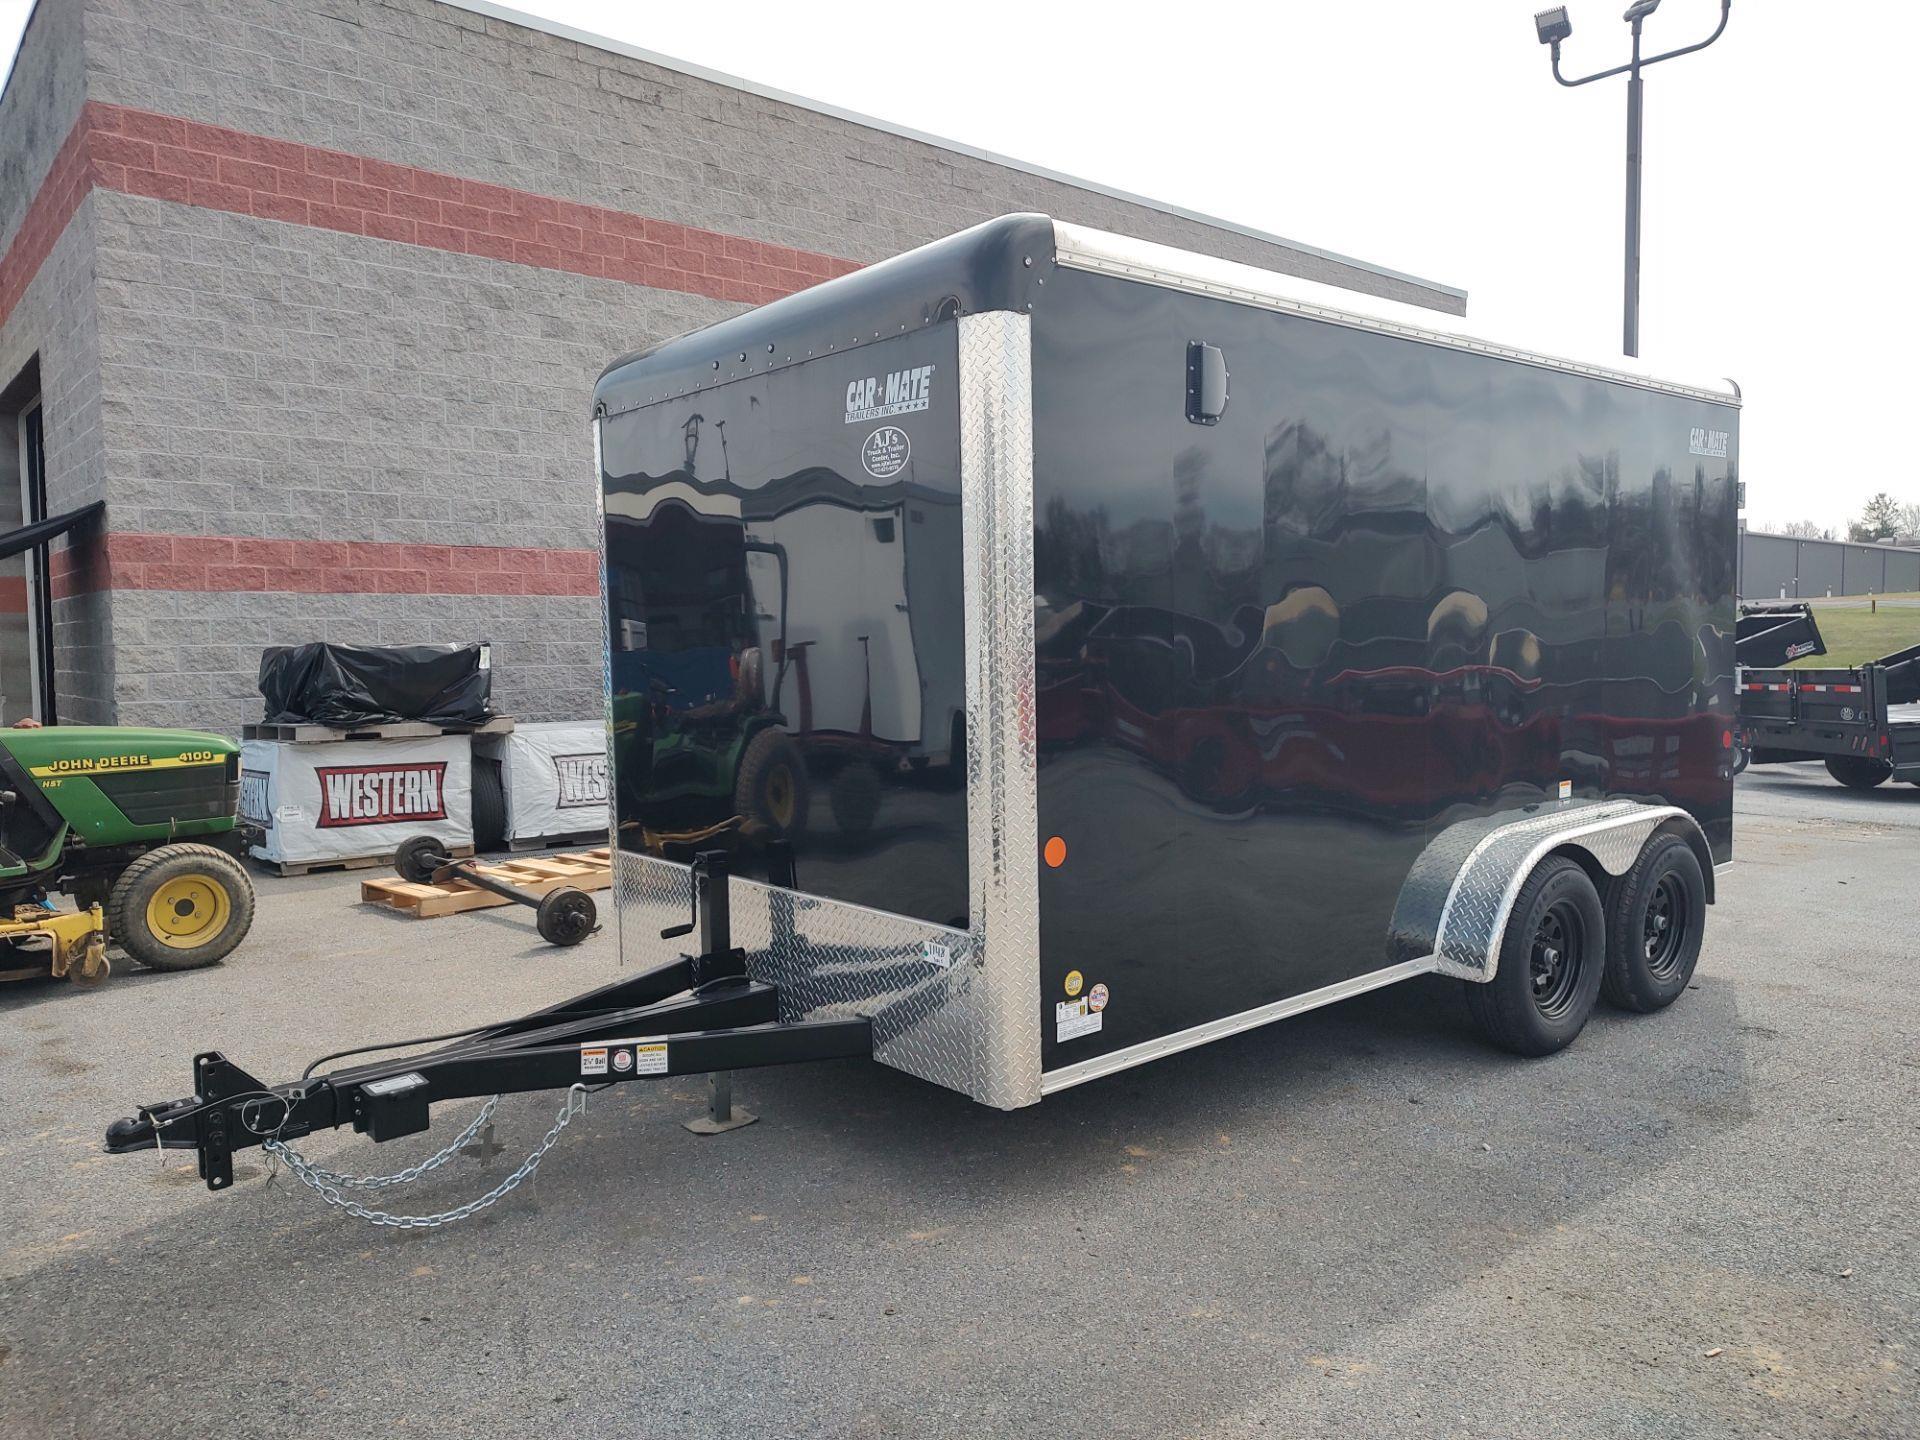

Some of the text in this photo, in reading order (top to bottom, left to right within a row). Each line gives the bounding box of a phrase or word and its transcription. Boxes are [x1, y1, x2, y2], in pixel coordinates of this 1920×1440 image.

[846, 365, 931, 413] CAR MATE
[846, 404, 896, 422] TRAILERS INC.
[873, 430, 898, 449] AJ's
[1690, 428, 1728, 450] CAR MATE
[867, 448, 882, 456] Truck
[888, 444, 905, 453] Trailer
[49, 751, 213, 772] JOHN DEERE 4100
[42, 780, 62, 789] HST
[560, 759, 608, 802] WES
[326, 768, 439, 820] WESTERN
